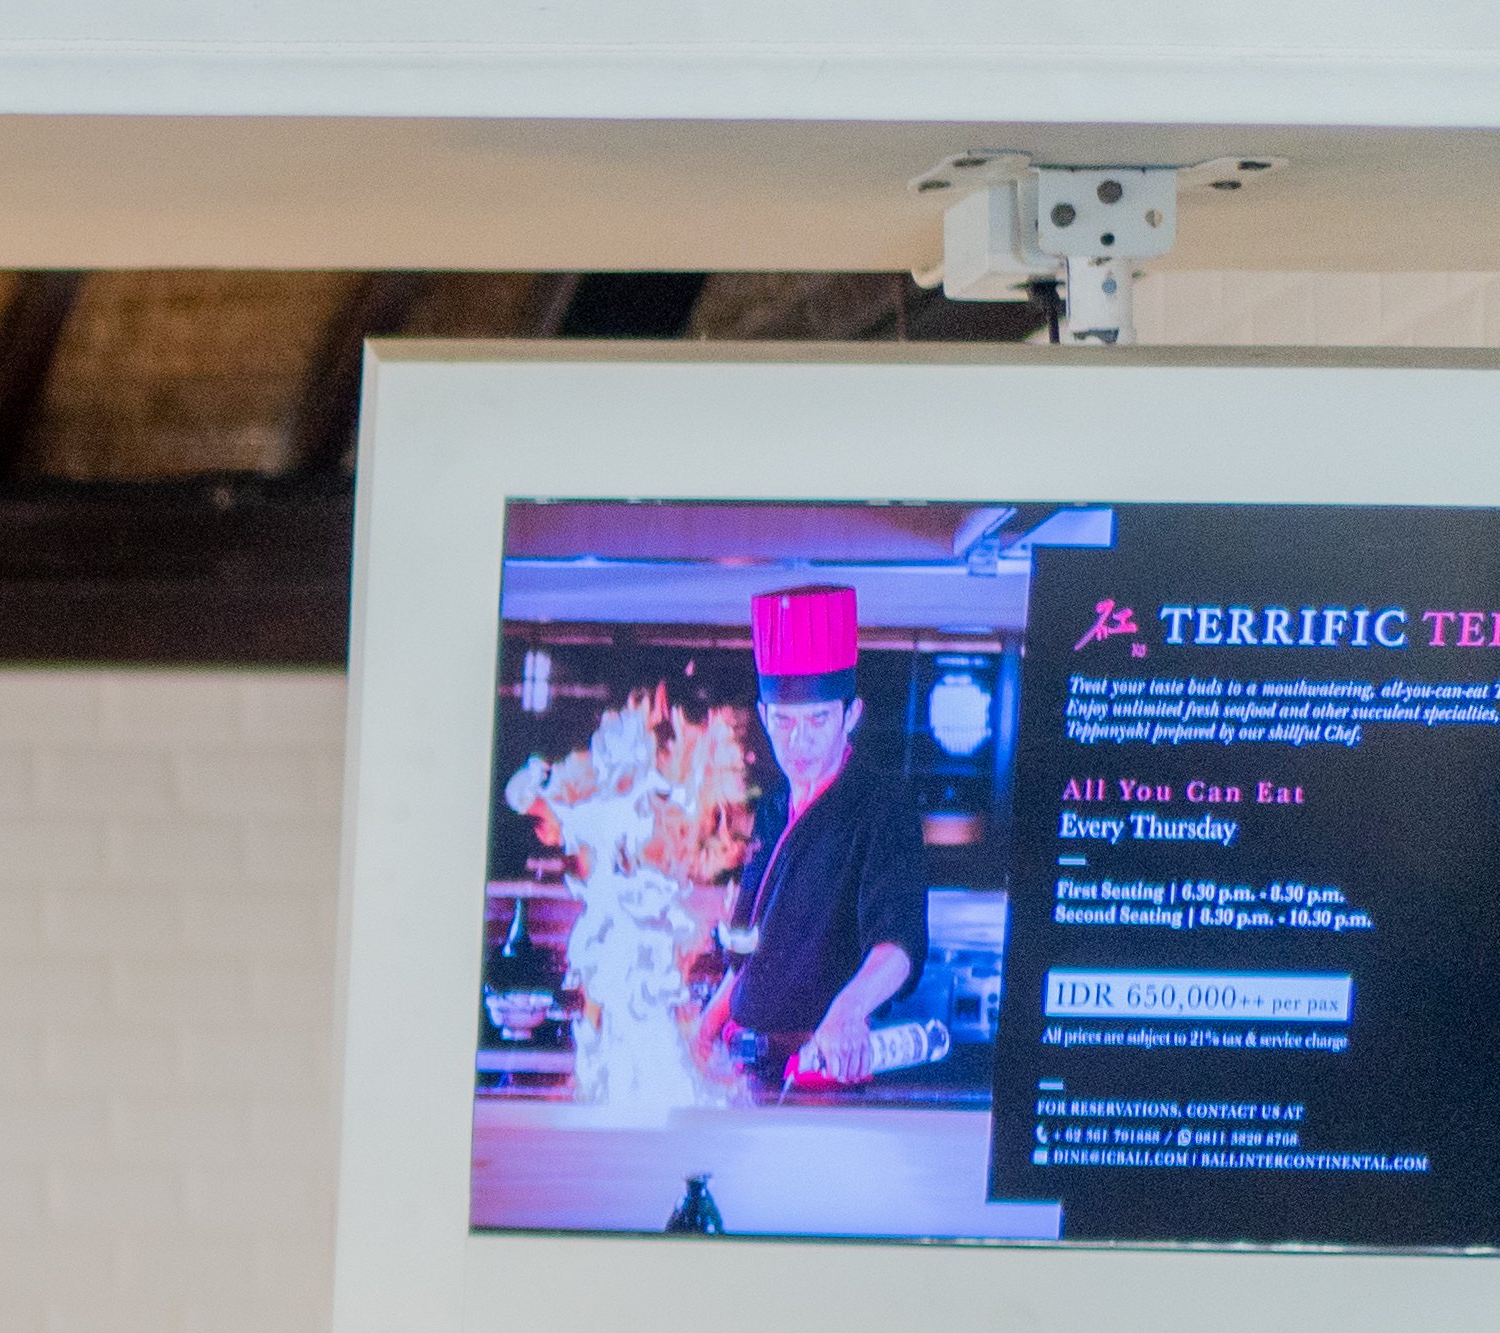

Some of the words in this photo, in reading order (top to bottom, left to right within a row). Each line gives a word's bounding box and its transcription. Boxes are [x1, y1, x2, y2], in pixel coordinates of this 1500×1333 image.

[1159, 606, 1407, 647] TERRIFIC
[1069, 676, 1108, 695] Treat
[1109, 680, 1146, 699] your
[1150, 678, 1184, 696] taste
[1188, 677, 1223, 696] buds
[1227, 680, 1242, 696] to
[1246, 683, 1257, 696] a
[1262, 679, 1376, 702] mouthwatering,
[1380, 680, 1489, 703] all-you-can-eat
[1066, 699, 1108, 720] Enjoy
[1113, 699, 1184, 718] unlimited
[1182, 700, 1219, 722] fresh
[1223, 701, 1276, 724] seafood
[1279, 702, 1310, 720] and
[1312, 702, 1350, 720] other
[1352, 704, 1420, 721] succulent
[1423, 705, 1500, 727] specialties,
[1067, 720, 1149, 744] Teppanyaki
[1152, 722, 1215, 745] prepared
[1219, 722, 1235, 746] by
[1239, 727, 1266, 741] our
[1267, 723, 1320, 747] skillful
[1324, 724, 1362, 747] Chef.
[1062, 779, 1106, 801] All
[1118, 779, 1173, 802] You
[1185, 780, 1242, 803] Can
[1256, 781, 1304, 805] Eat
[1059, 811, 1124, 845] Every
[1130, 812, 1238, 847] Thursday
[1056, 880, 1098, 900] First
[1101, 881, 1166, 906] Seating
[1218, 886, 1256, 906] p.m.
[1306, 889, 1346, 907] p.m.
[1054, 903, 1116, 924] Second
[1119, 904, 1184, 930] Seating
[1236, 911, 1275, 931] p.m.
[1290, 909, 1332, 927] 10.30
[1334, 914, 1373, 932] p.m.
[1056, 981, 1115, 1008] IDR
[1272, 999, 1303, 1014] per
[1306, 999, 1340, 1016] pax
[1042, 1026, 1062, 1045] All
[1063, 1027, 1102, 1048] prices
[1104, 1031, 1125, 1045] are
[1127, 1030, 1171, 1050] subject
[1173, 1032, 1187, 1046] to
[1222, 1032, 1243, 1047] tax
[1260, 1032, 1302, 1049] service
[1304, 1032, 1348, 1053] charge
[1036, 1099, 1067, 1117] FOR
[1186, 1103, 1258, 1120] CONTACT
[1262, 1105, 1280, 1121] US
[1283, 1106, 1304, 1121] AT
